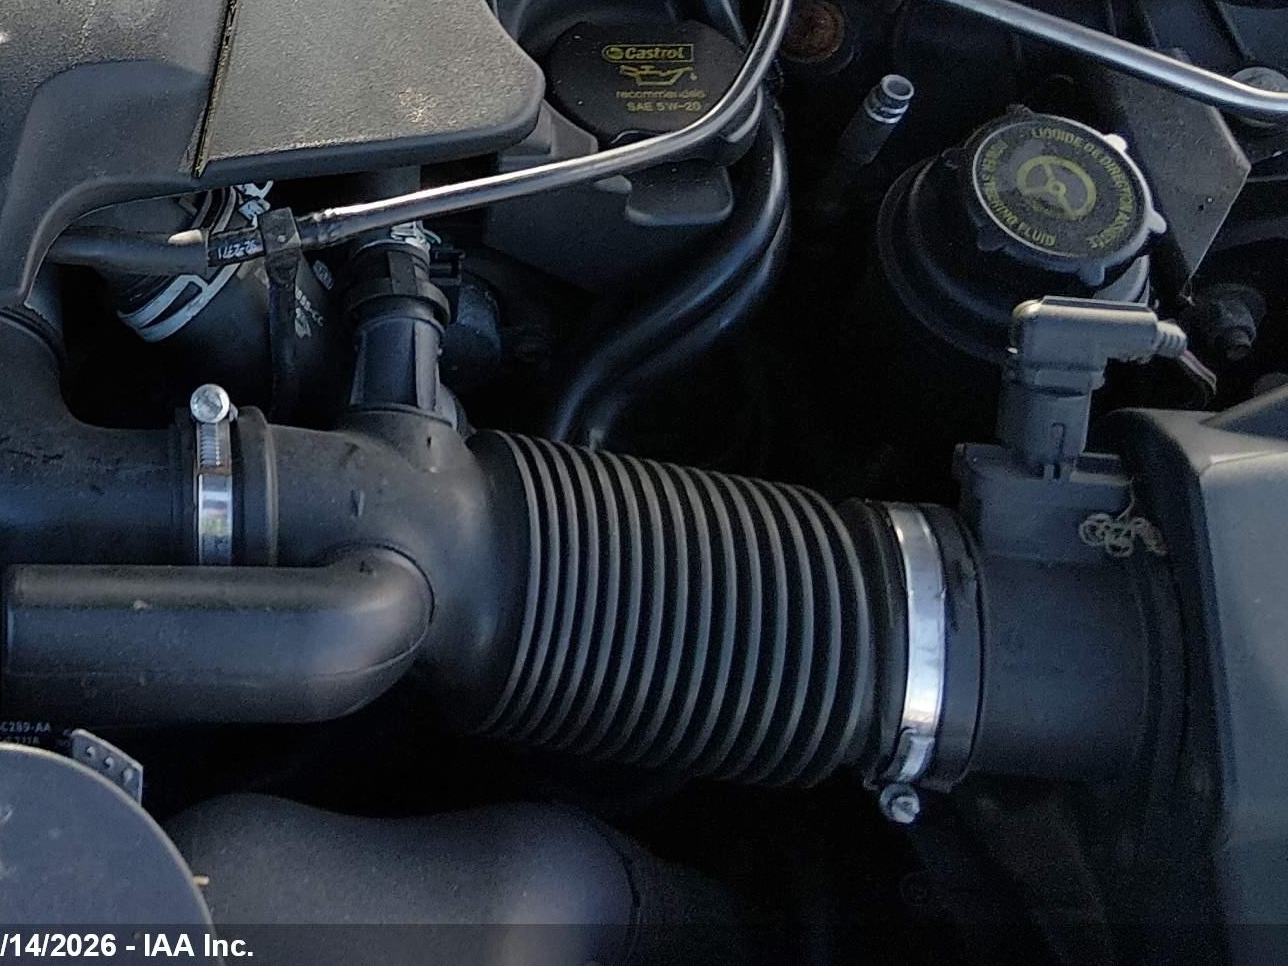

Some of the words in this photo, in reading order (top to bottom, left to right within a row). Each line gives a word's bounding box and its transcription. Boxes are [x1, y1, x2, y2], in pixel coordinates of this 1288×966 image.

[624, 47, 685, 59] Castrol
[626, 101, 653, 113] SAE
[655, 101, 702, 113] 5W-20
[1031, 126, 1082, 147] LIQUIDE
[1016, 221, 1056, 247] FLUID
